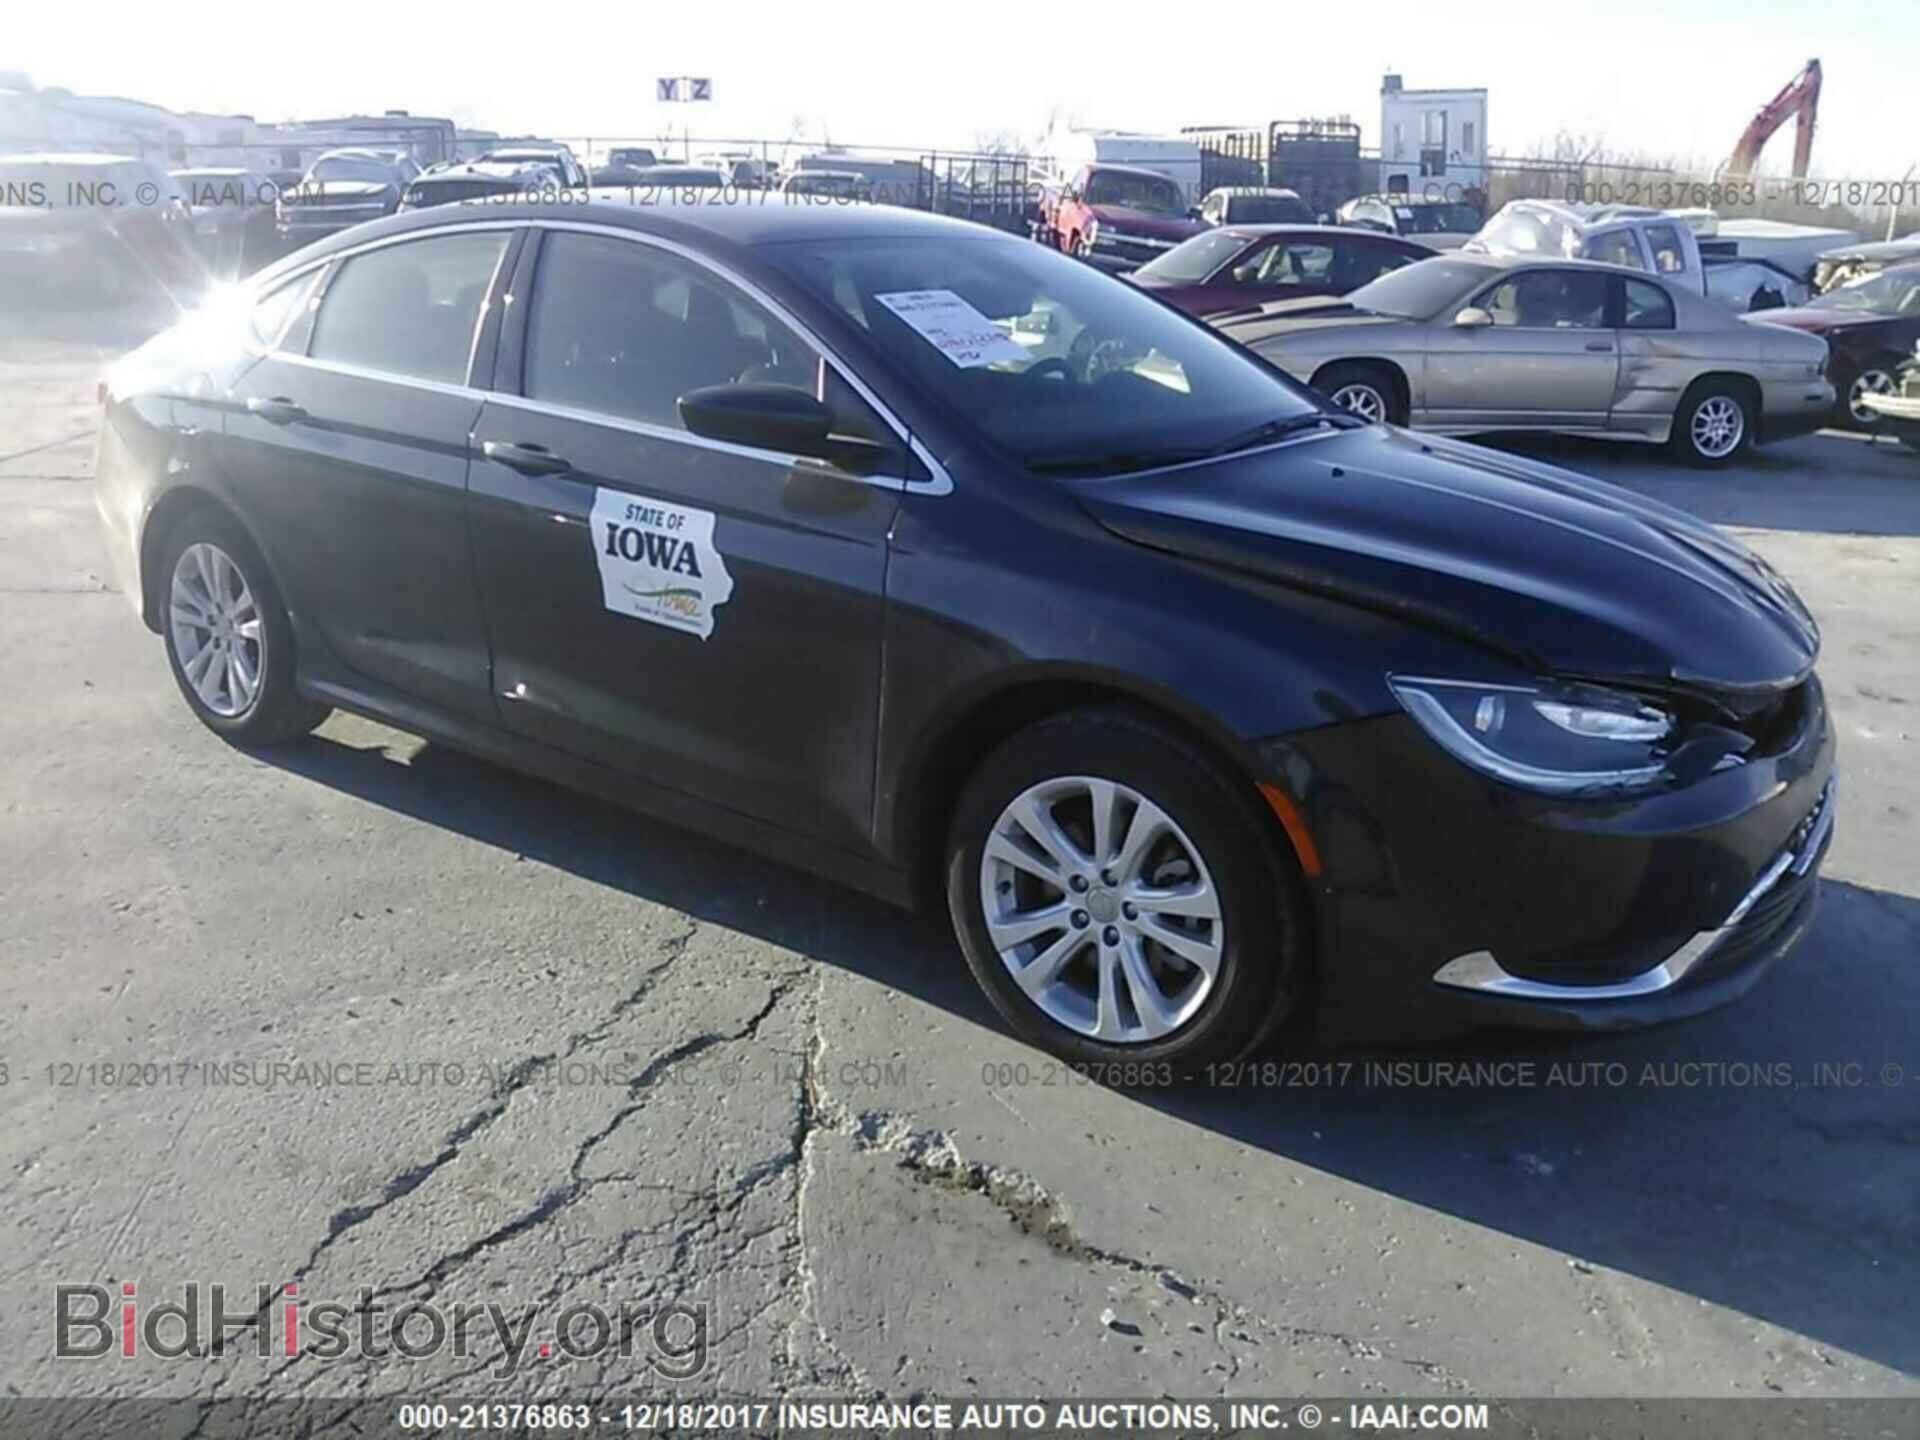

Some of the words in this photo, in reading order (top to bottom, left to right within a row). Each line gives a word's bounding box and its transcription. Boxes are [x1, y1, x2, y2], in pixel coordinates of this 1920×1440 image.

[658, 78, 677, 100] Y
[692, 78, 710, 100] Z
[625, 503, 664, 527] STATE
[667, 513, 686, 531] OF
[605, 521, 703, 579] IOWA
